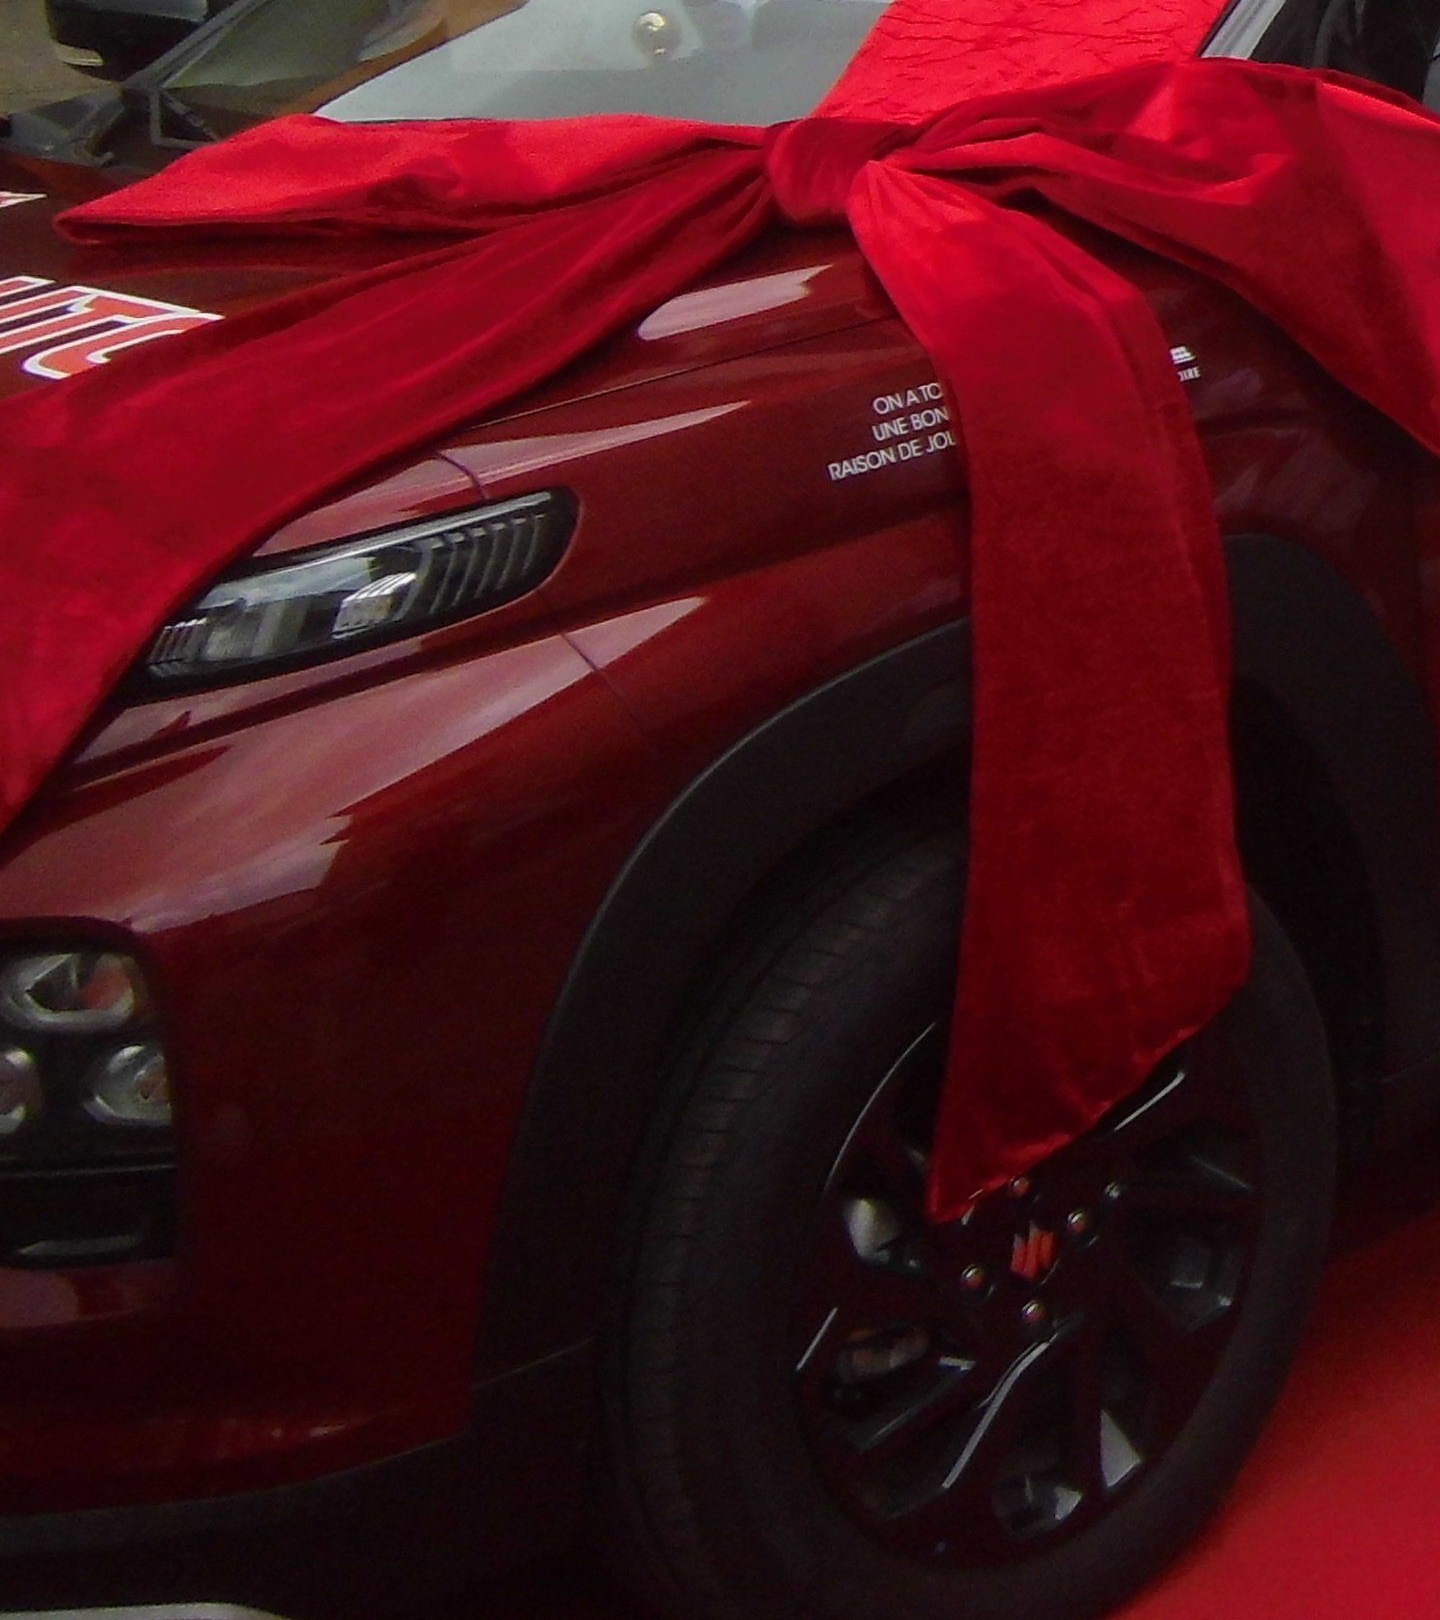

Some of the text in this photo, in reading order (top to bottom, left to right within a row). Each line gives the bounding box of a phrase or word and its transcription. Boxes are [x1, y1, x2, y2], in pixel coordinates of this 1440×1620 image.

[872, 382, 944, 415] ON A TO
[871, 406, 949, 442] UNE BON
[827, 447, 897, 481] RAISON
[897, 438, 923, 461] DE
